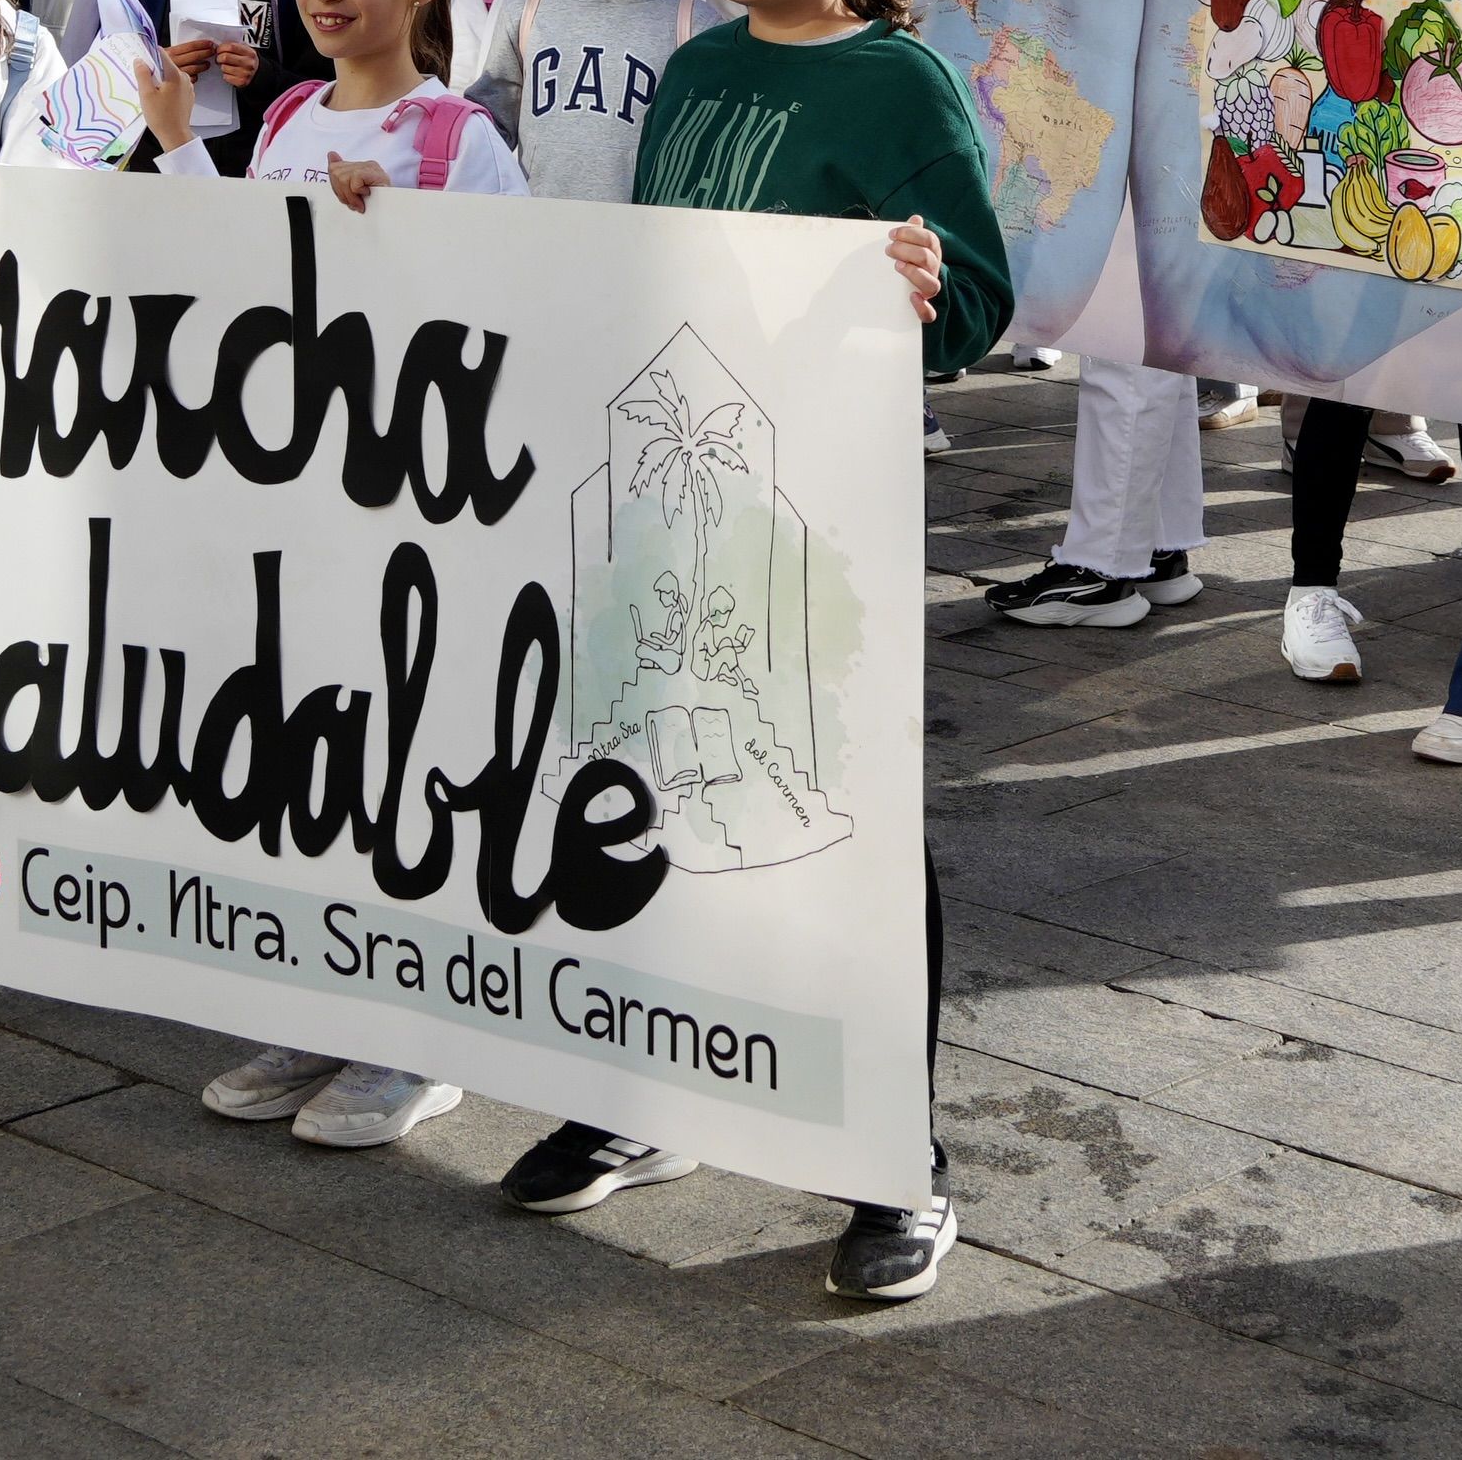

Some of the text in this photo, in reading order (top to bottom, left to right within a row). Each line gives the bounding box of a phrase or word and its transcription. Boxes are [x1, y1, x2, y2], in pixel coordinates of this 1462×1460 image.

[532, 45, 657, 125] GAP
[641, 99, 789, 212] MILANO
[620, 721, 641, 740] Sra
[744, 738, 766, 765] del
[767, 762, 811, 828] Carmen
[22, 846, 779, 1092] Ceip. Ntra. Sra del Carmen
